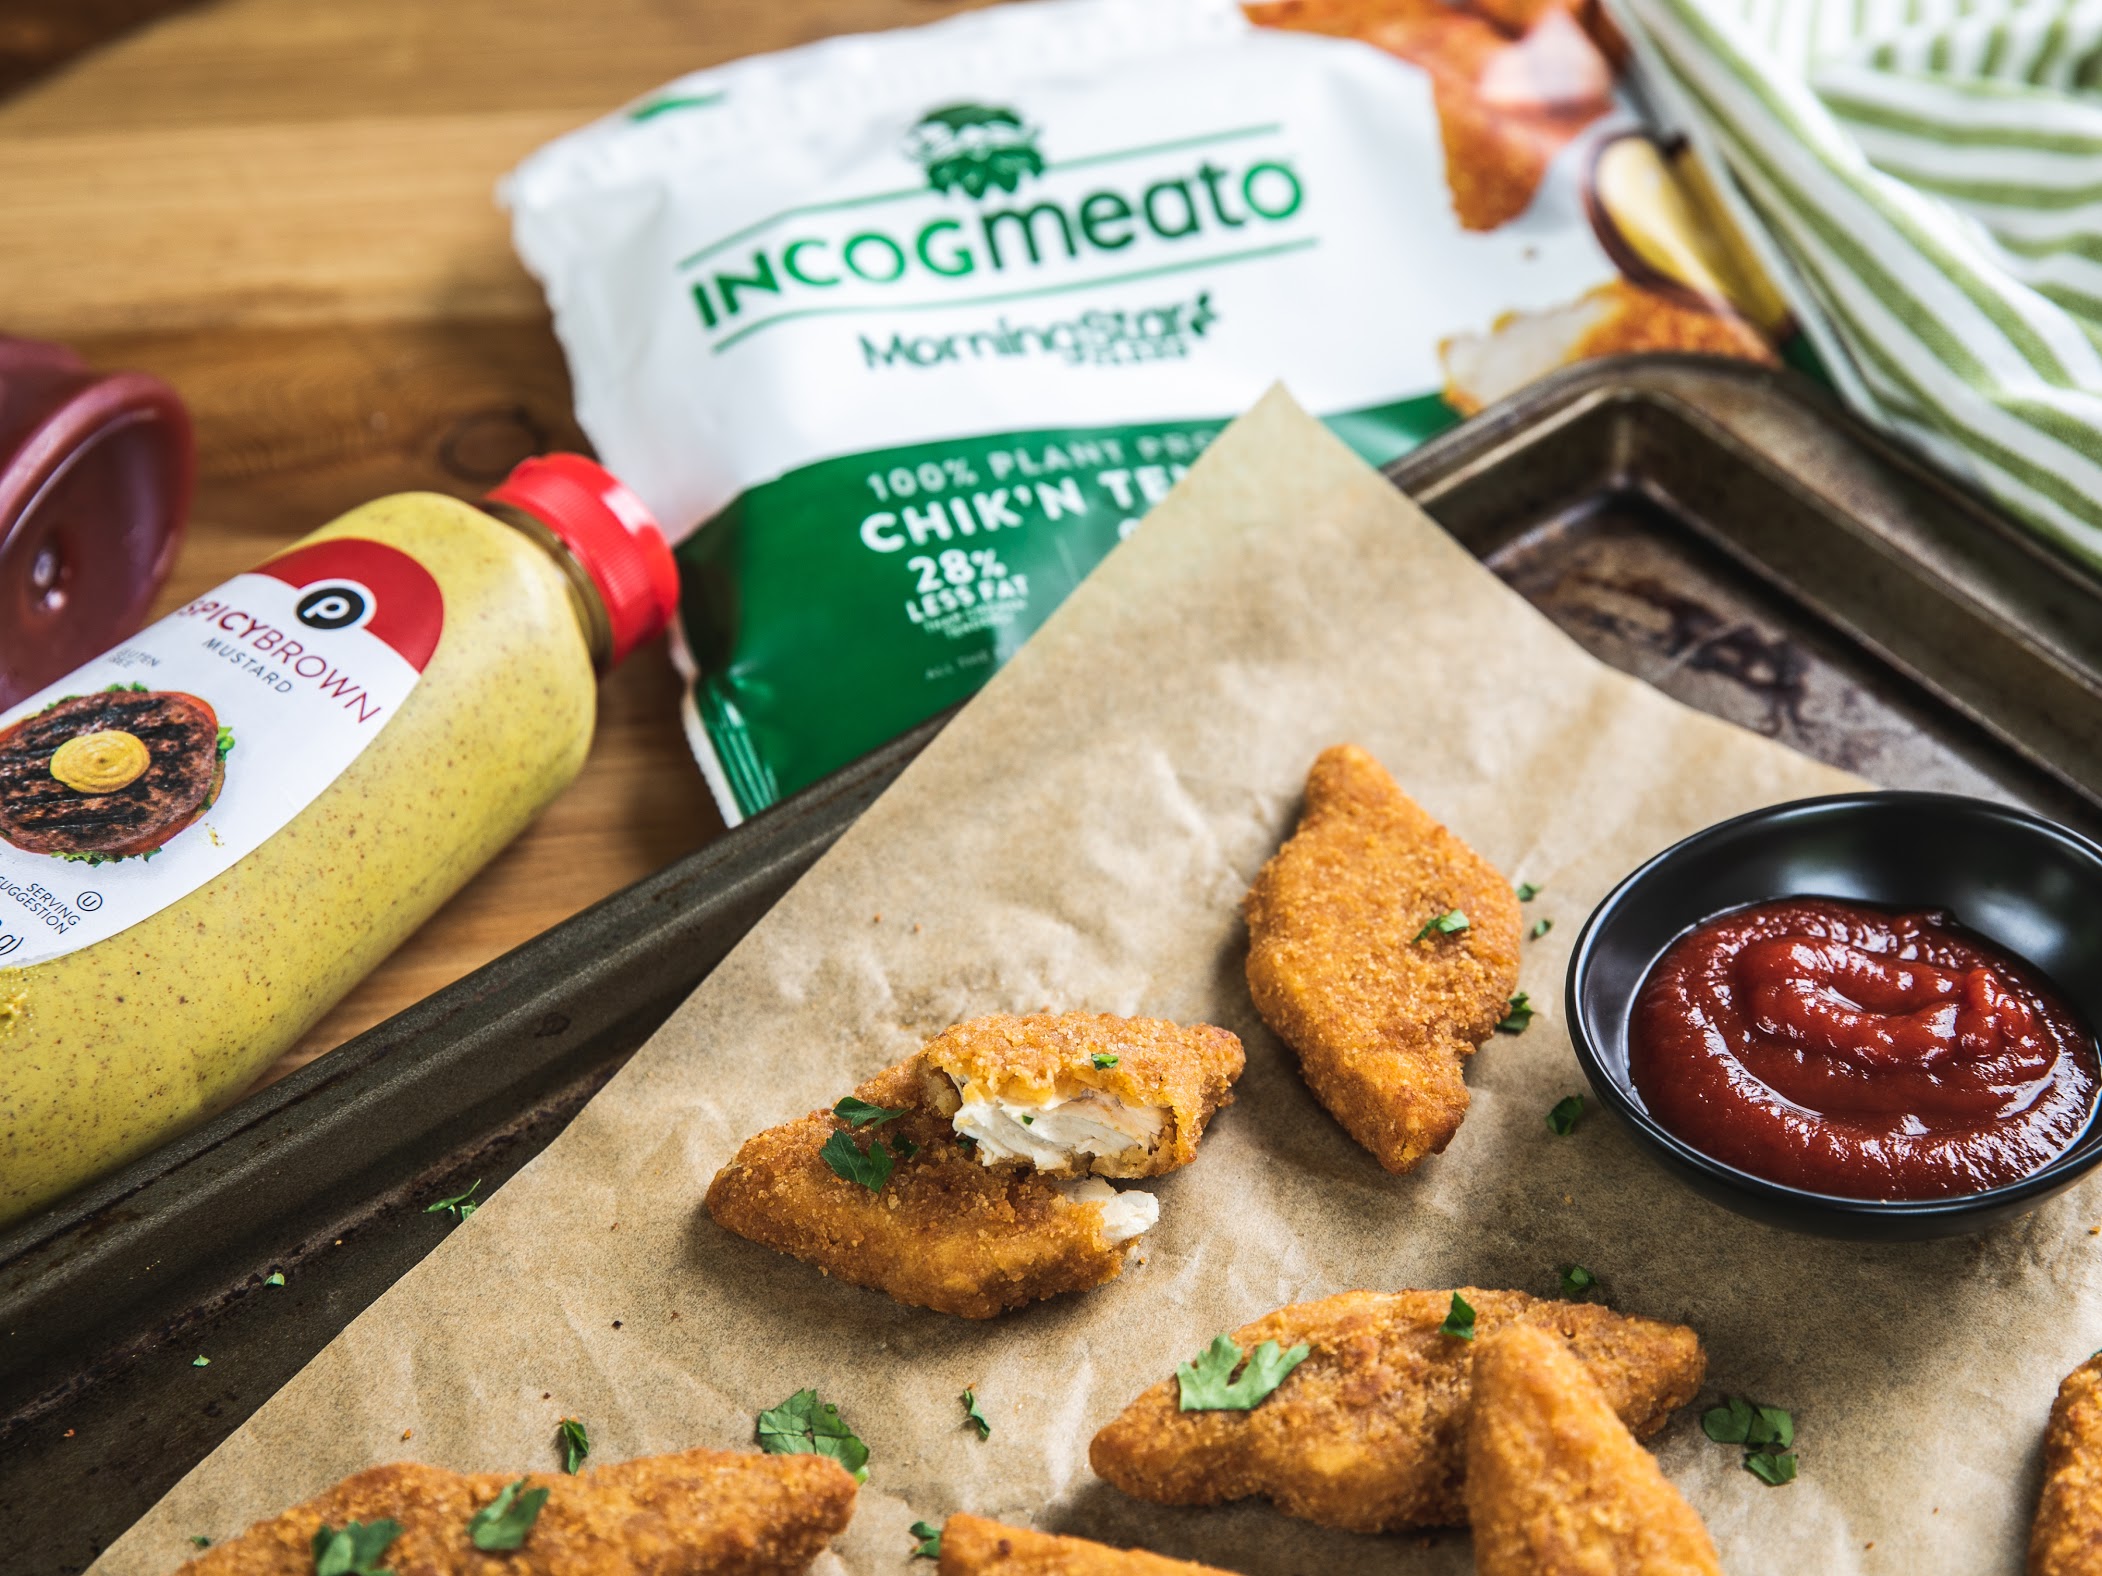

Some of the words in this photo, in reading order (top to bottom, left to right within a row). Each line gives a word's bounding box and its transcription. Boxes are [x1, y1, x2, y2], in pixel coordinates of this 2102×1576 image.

[691, 160, 1302, 328] INCOGmeato
[867, 458, 978, 501] 100%
[987, 439, 1124, 481] PLANT
[860, 477, 1087, 553] CHIK'N
[908, 548, 1007, 594] 28%
[906, 585, 976, 624] LESS
[202, 638, 293, 694] MUSTARD
[26, 883, 81, 926] SERVING
